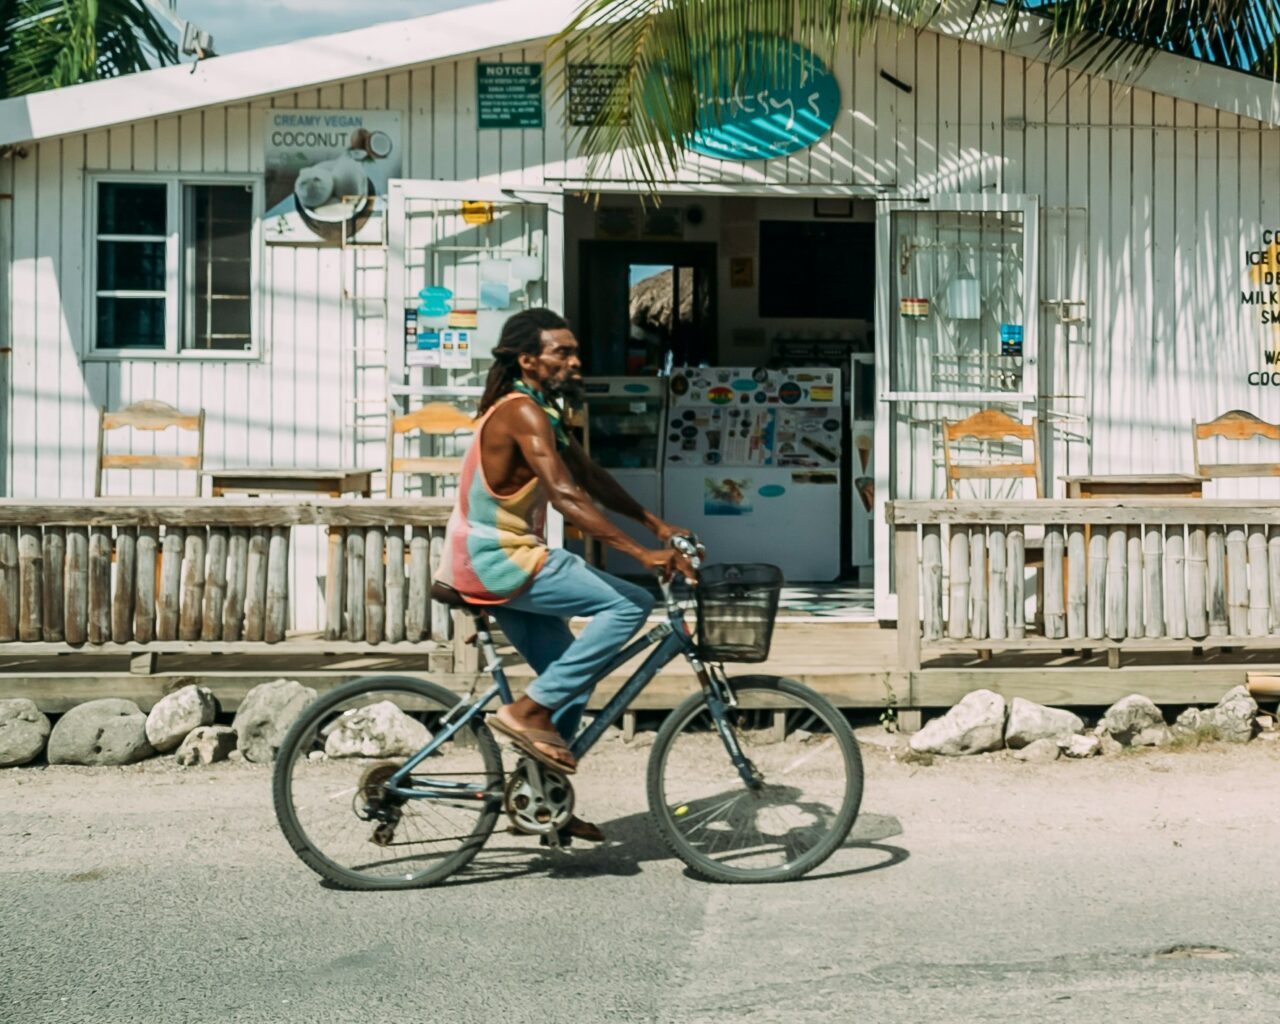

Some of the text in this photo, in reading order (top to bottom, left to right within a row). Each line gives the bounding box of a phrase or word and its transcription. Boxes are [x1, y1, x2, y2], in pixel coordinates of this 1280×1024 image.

[486, 66, 531, 75] NOTICE
[273, 115, 363, 127] CREAMY VEGAN
[271, 131, 348, 147] COCONUT
[1245, 251, 1269, 266] ICE
[1240, 291, 1278, 305] MILK
